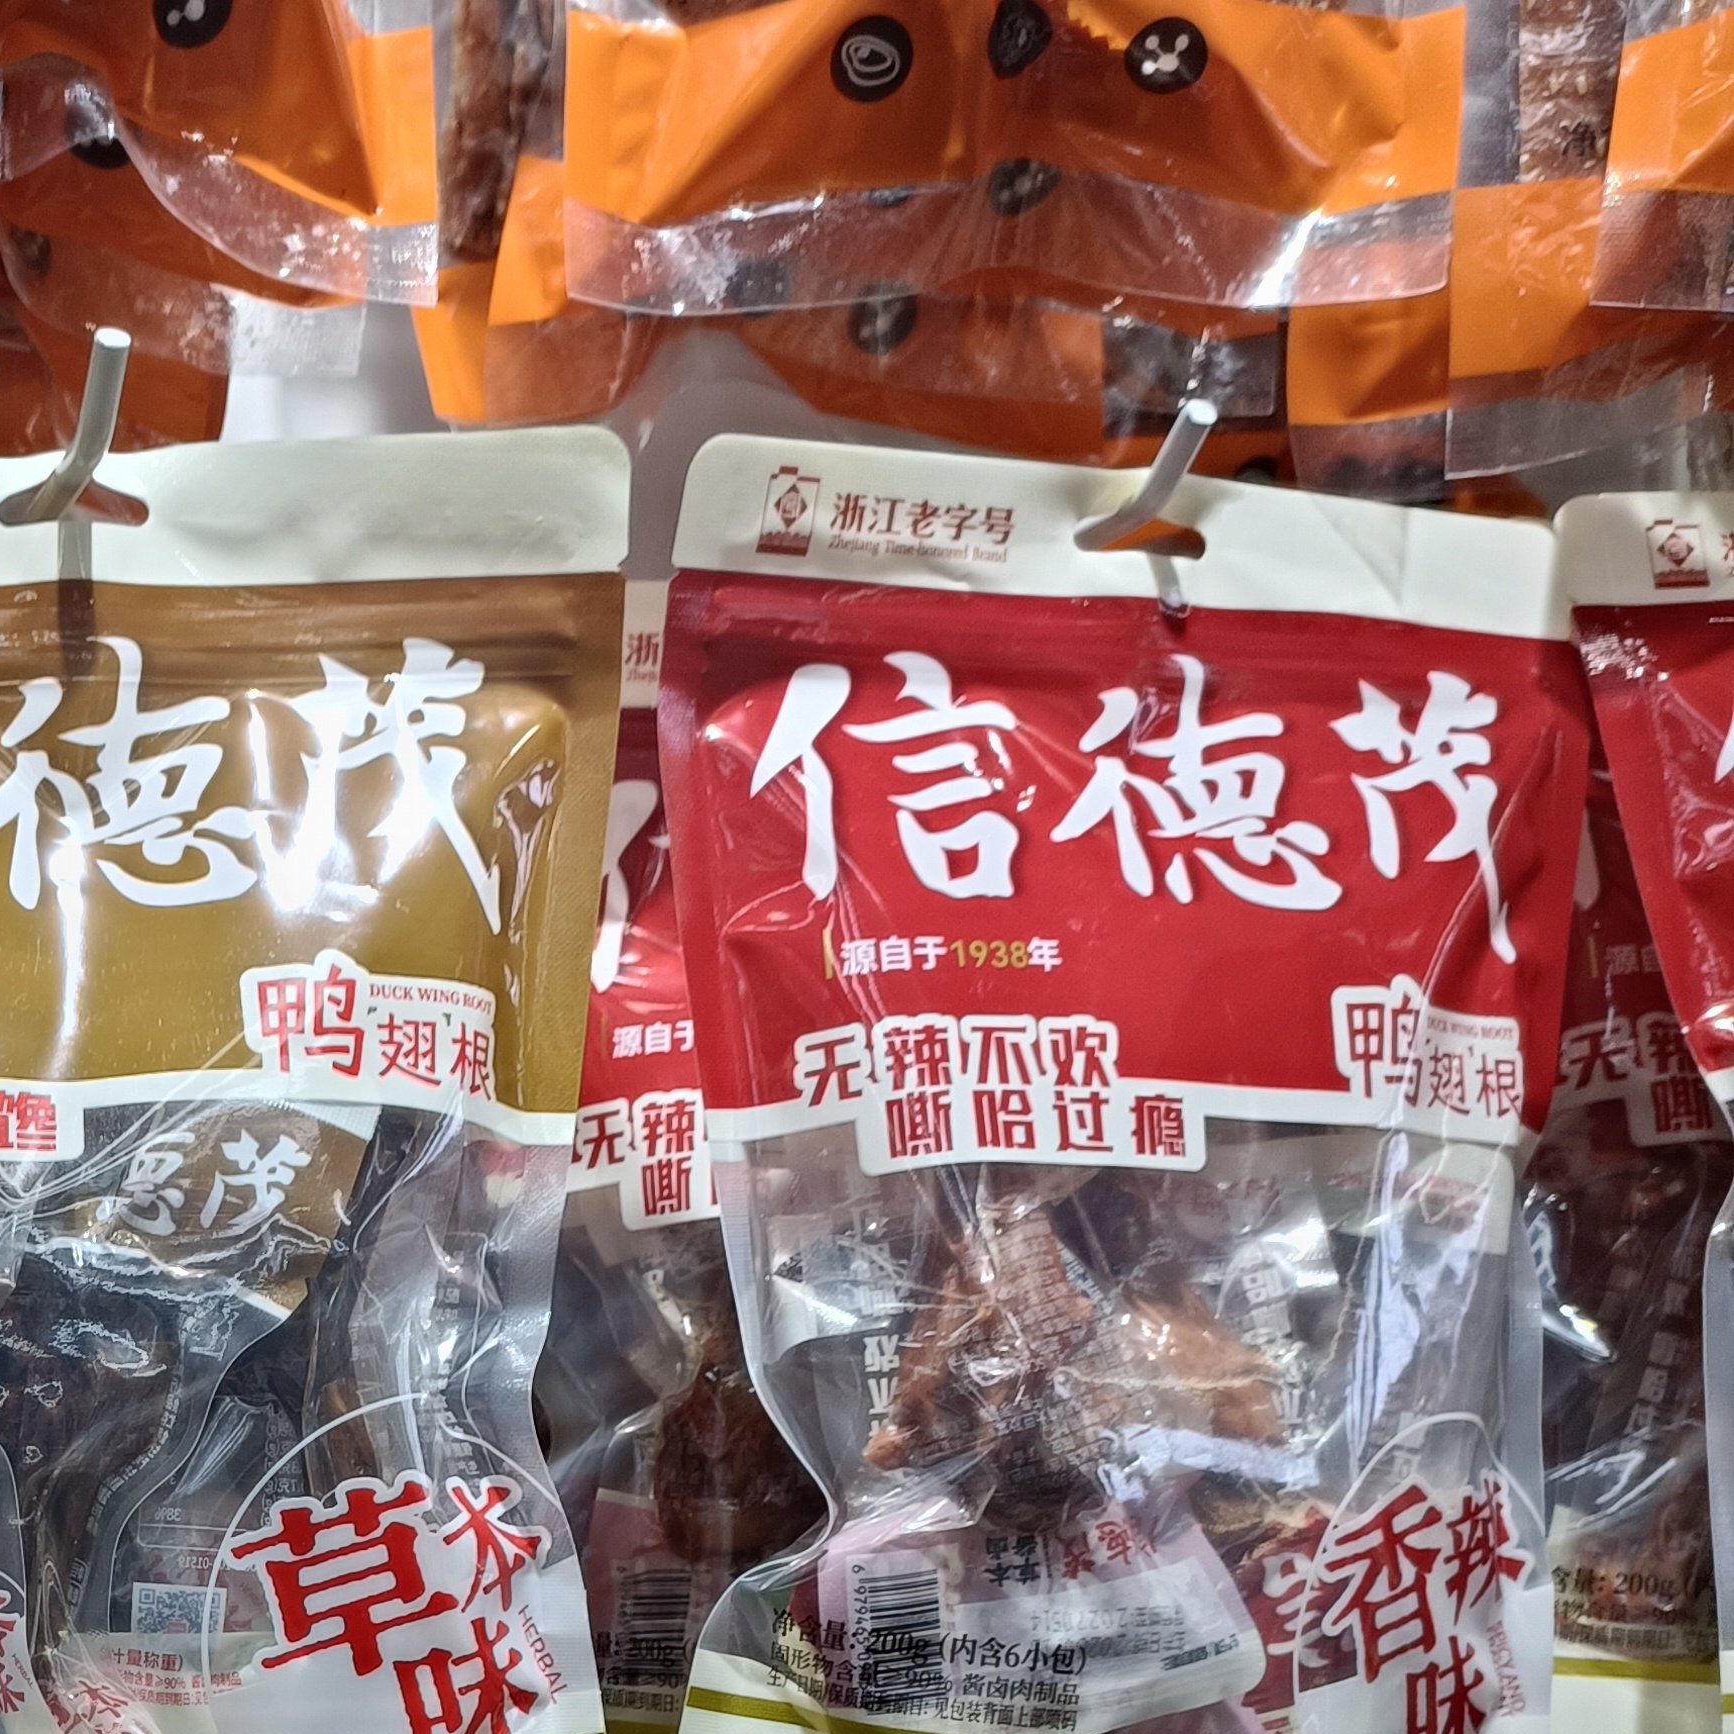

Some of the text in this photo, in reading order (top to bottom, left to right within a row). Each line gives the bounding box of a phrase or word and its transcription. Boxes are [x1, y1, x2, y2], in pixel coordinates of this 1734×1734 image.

[831, 493, 1014, 544] 浙江老字号
[750, 651, 1516, 964] 信德茂
[841, 936, 1062, 975] 源自于1938年
[257, 966, 492, 1102] 鸭翅根
[369, 983, 493, 1014] DUCK WING ROOT
[804, 1024, 1110, 1108] 无辣不欢
[1346, 994, 1523, 1119] 鸭翅根
[887, 1090, 1186, 1158] 嘶哈过瘾
[518, 1604, 568, 1705] HERBAL
[962, 1674, 1081, 1705] 酱卤肉制品
